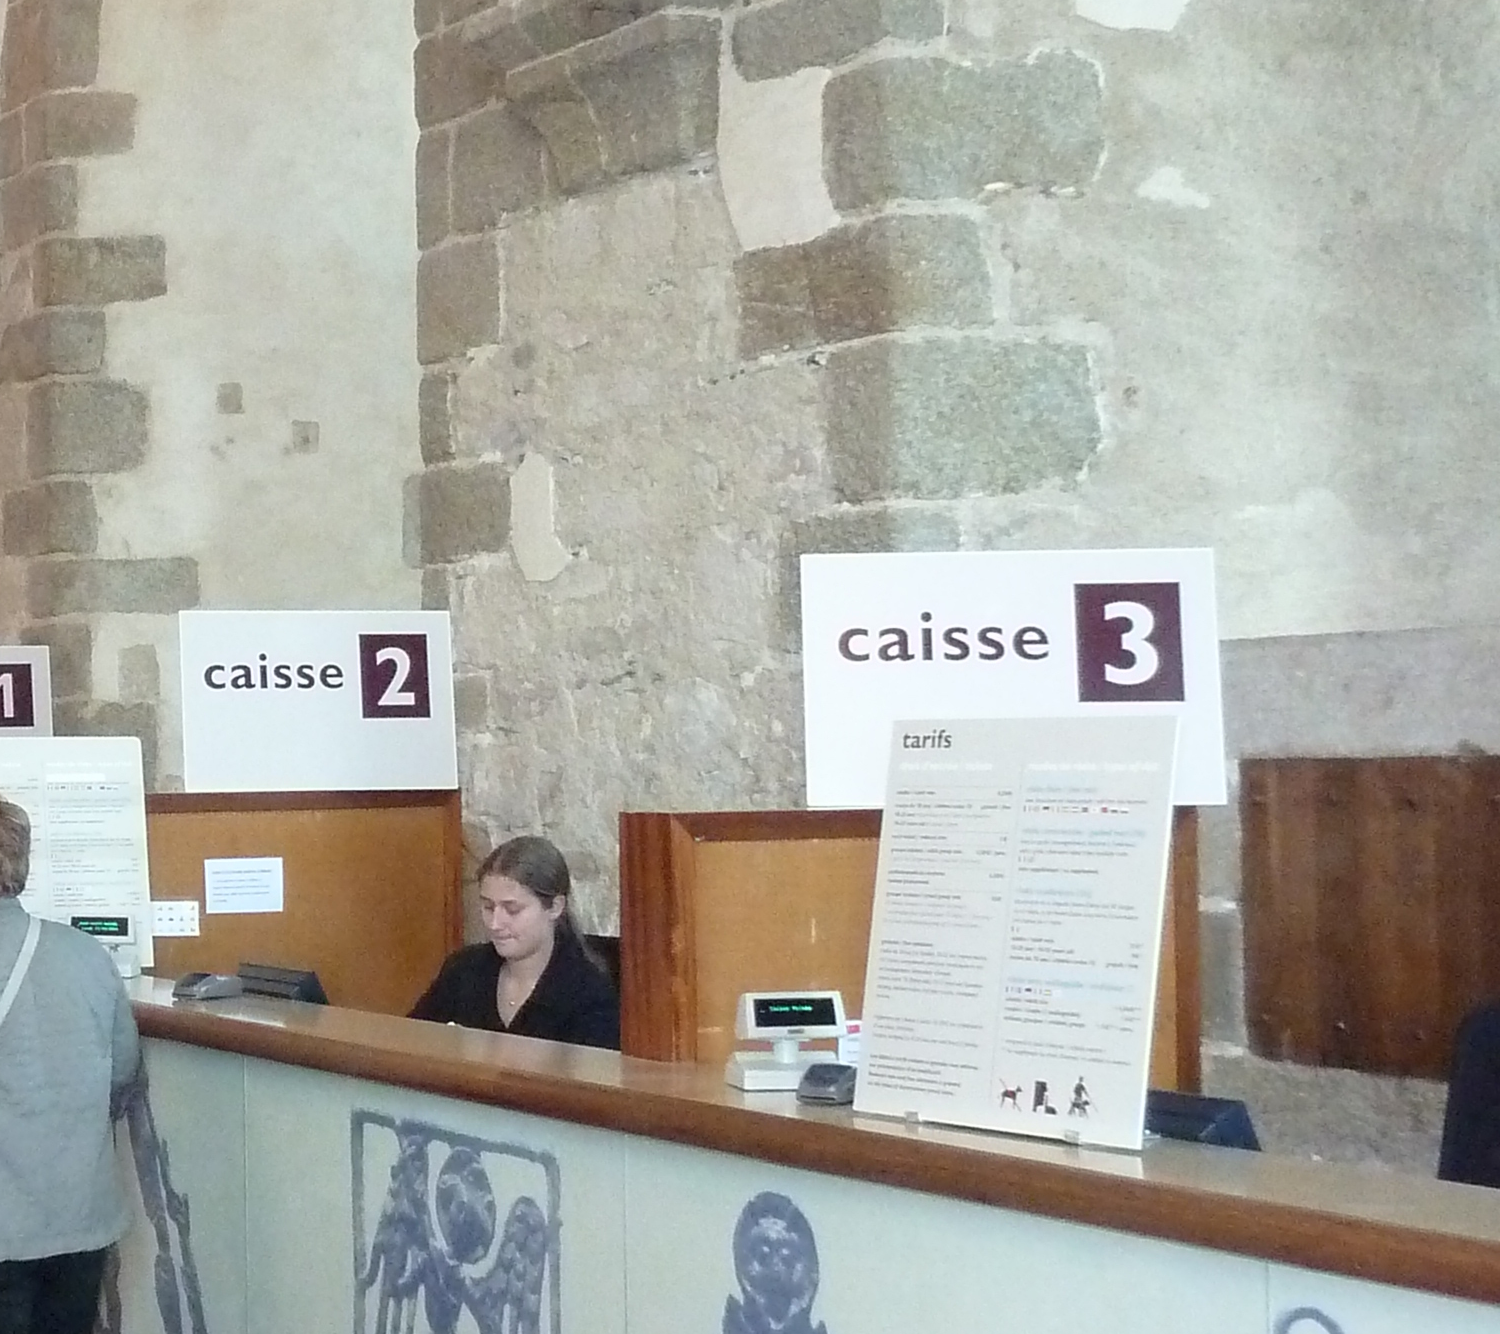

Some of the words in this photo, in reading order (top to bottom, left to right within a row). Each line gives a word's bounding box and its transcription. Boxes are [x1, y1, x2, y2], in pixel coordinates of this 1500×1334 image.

[838, 611, 1049, 662] caisse
[1103, 600, 1160, 685] 3
[204, 653, 344, 690] caisse
[375, 646, 416, 706] 2
[903, 729, 952, 749] tarifs
